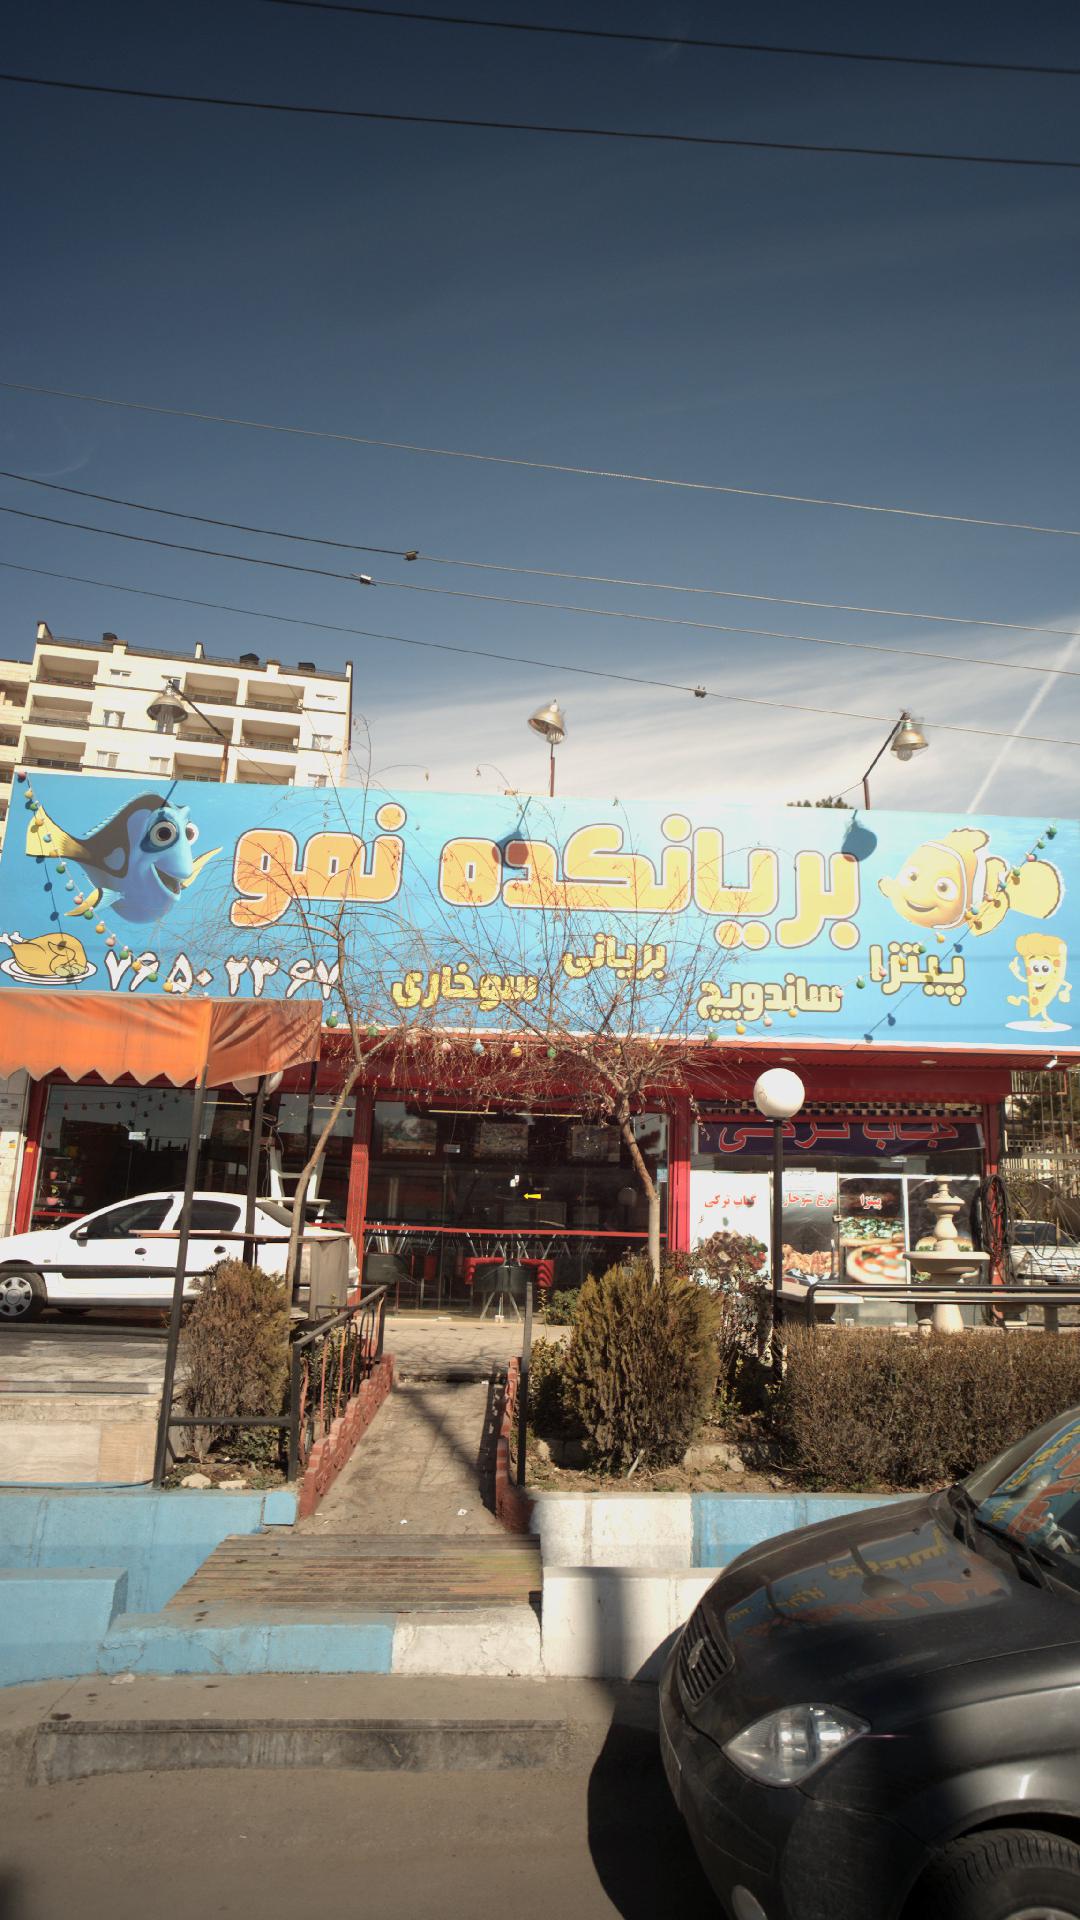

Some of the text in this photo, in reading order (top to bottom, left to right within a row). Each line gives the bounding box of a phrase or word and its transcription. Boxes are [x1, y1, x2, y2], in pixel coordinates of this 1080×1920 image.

[230, 802, 860, 950] بریانکده نمو
[562, 931, 667, 980] بریانی
[868, 941, 967, 1006] پیتزا
[391, 962, 537, 1011] سوخاری
[697, 972, 842, 1022] ساندویچ
